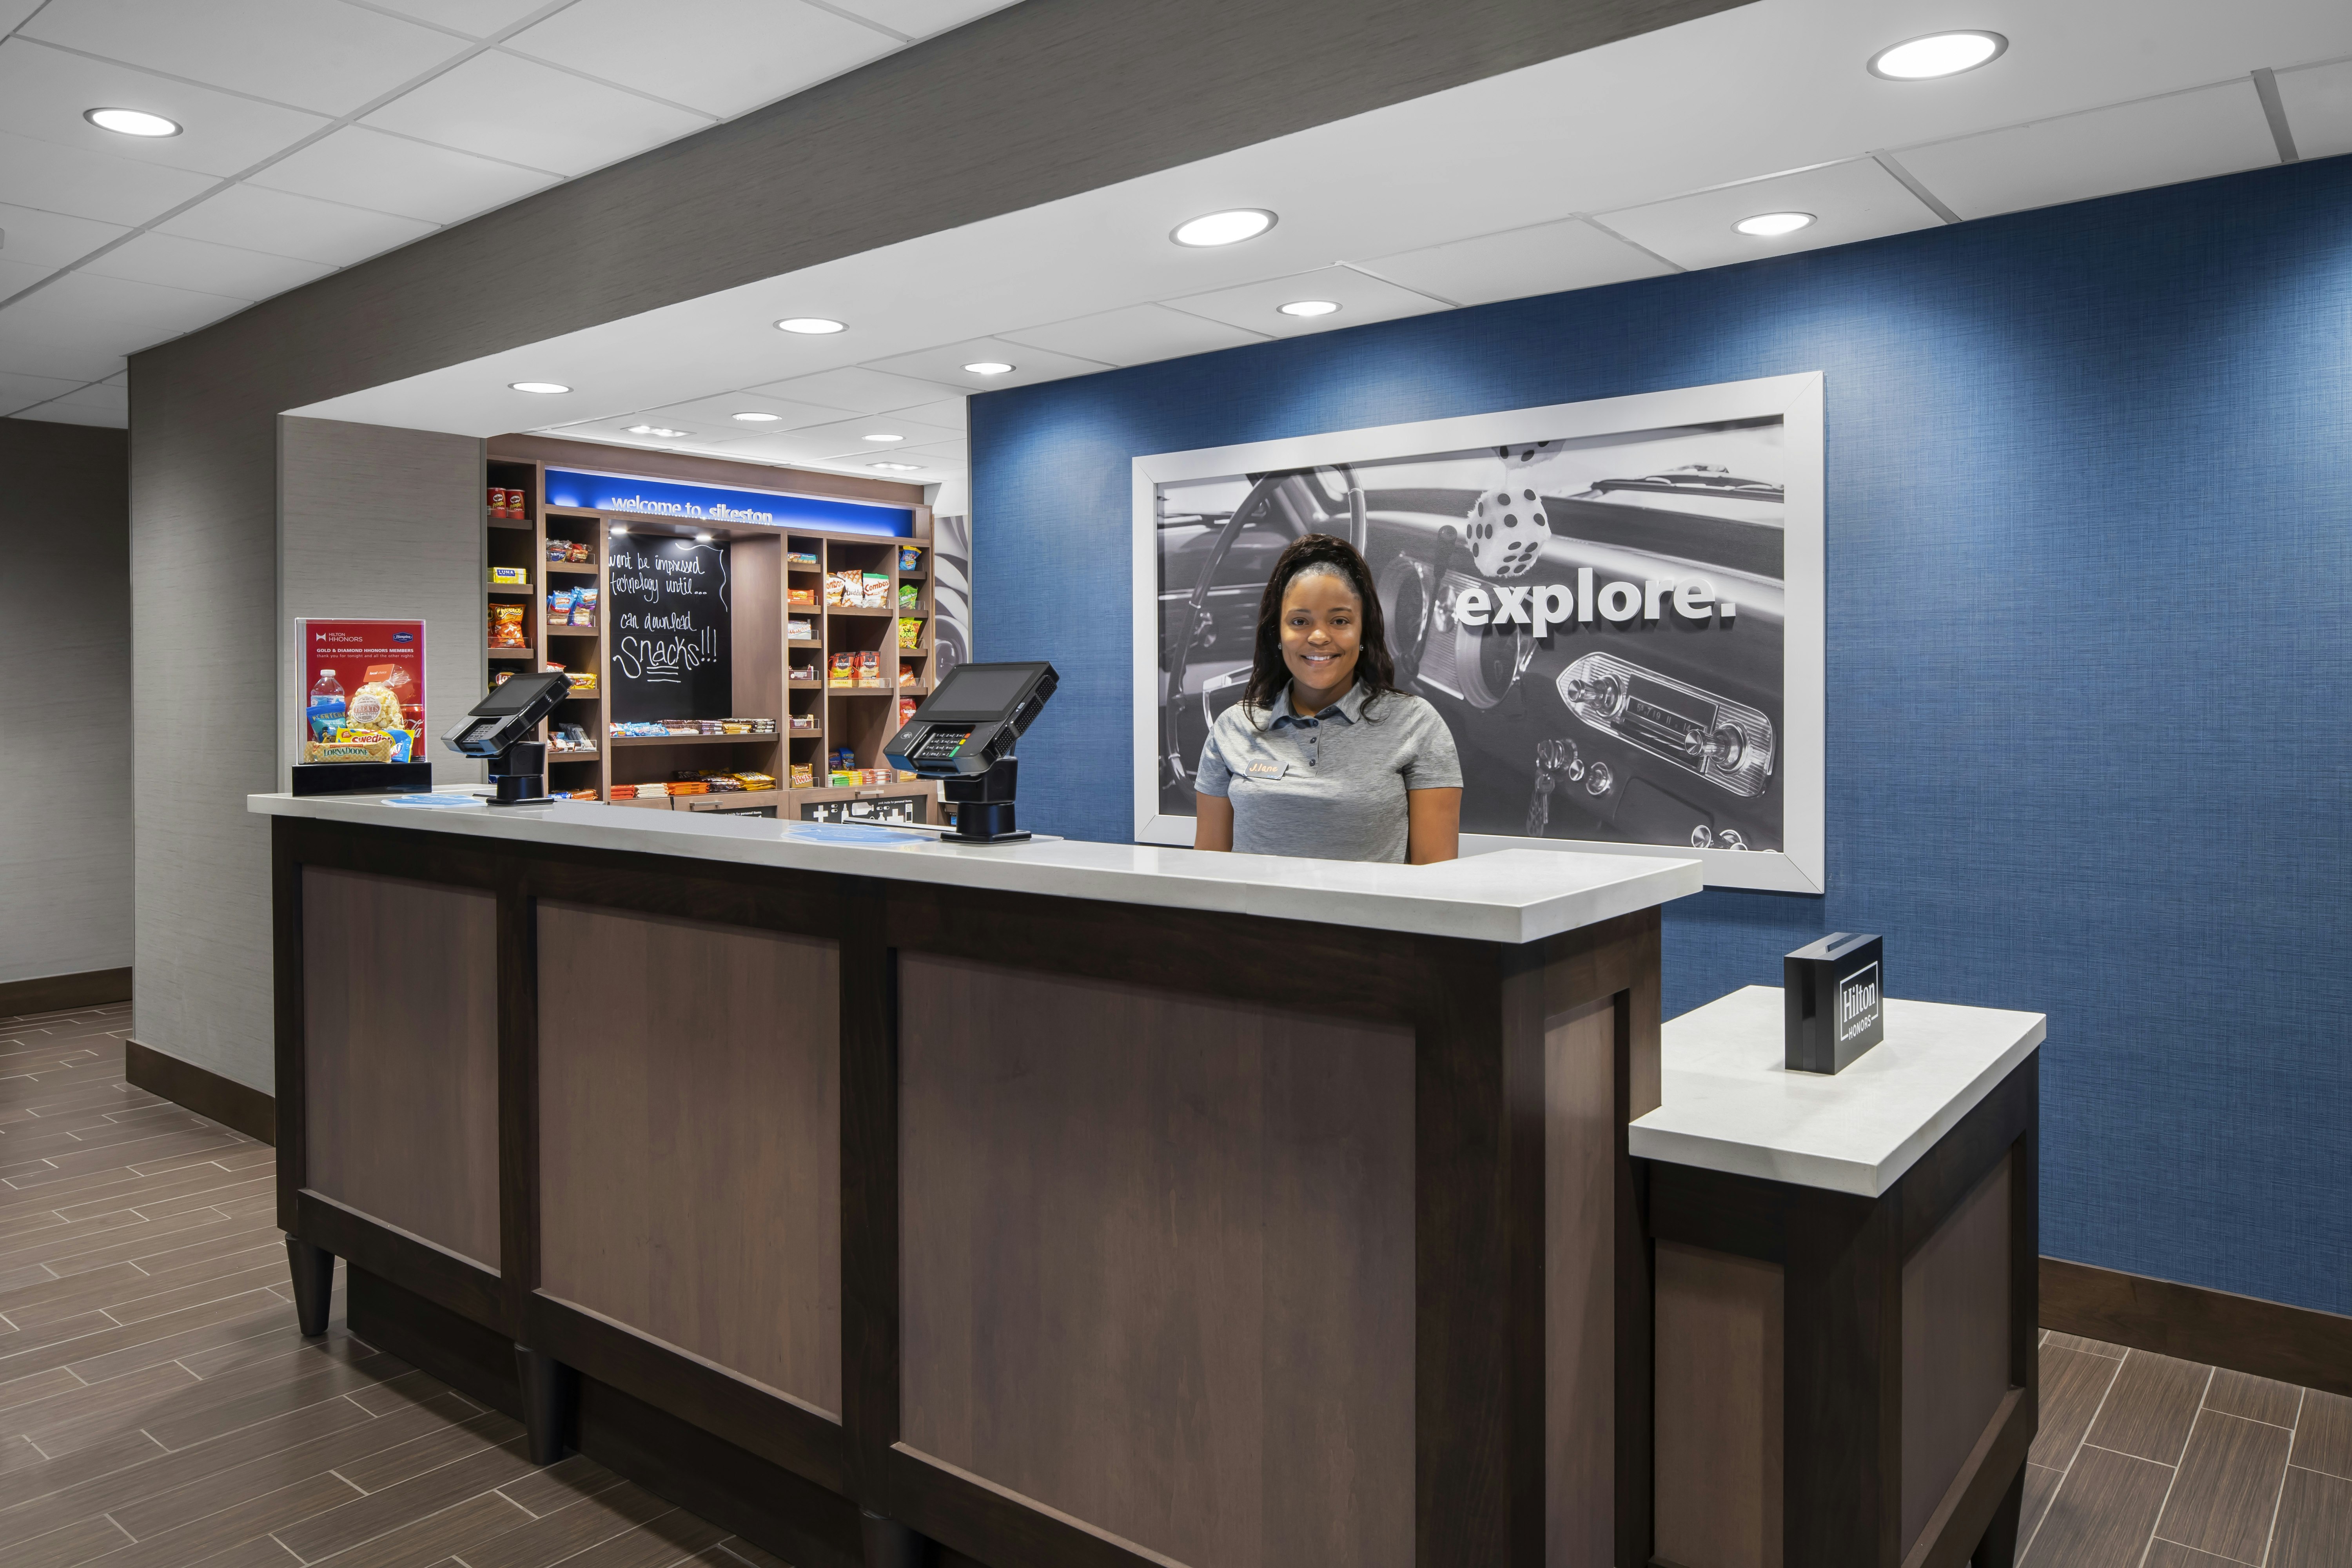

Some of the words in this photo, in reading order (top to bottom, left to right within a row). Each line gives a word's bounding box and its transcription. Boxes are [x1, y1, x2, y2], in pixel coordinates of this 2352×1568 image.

[493, 501, 504, 509] Pringles
[611, 495, 682, 513] welcome
[685, 502, 702, 516] to
[709, 504, 773, 524] sikeston
[637, 552, 650, 570] be
[655, 555, 705, 575] impressed
[610, 572, 659, 603] technology
[865, 581, 889, 592] Combos
[495, 607, 523, 618] Cheetos
[1455, 567, 1736, 638] explore.
[621, 613, 639, 629] can
[644, 611, 697, 632] download
[323, 748, 345, 757] LORNA
[345, 747, 369, 756] DOONE
[1844, 983, 1876, 1023] Hilton
[1849, 1014, 1871, 1040] HONORS
